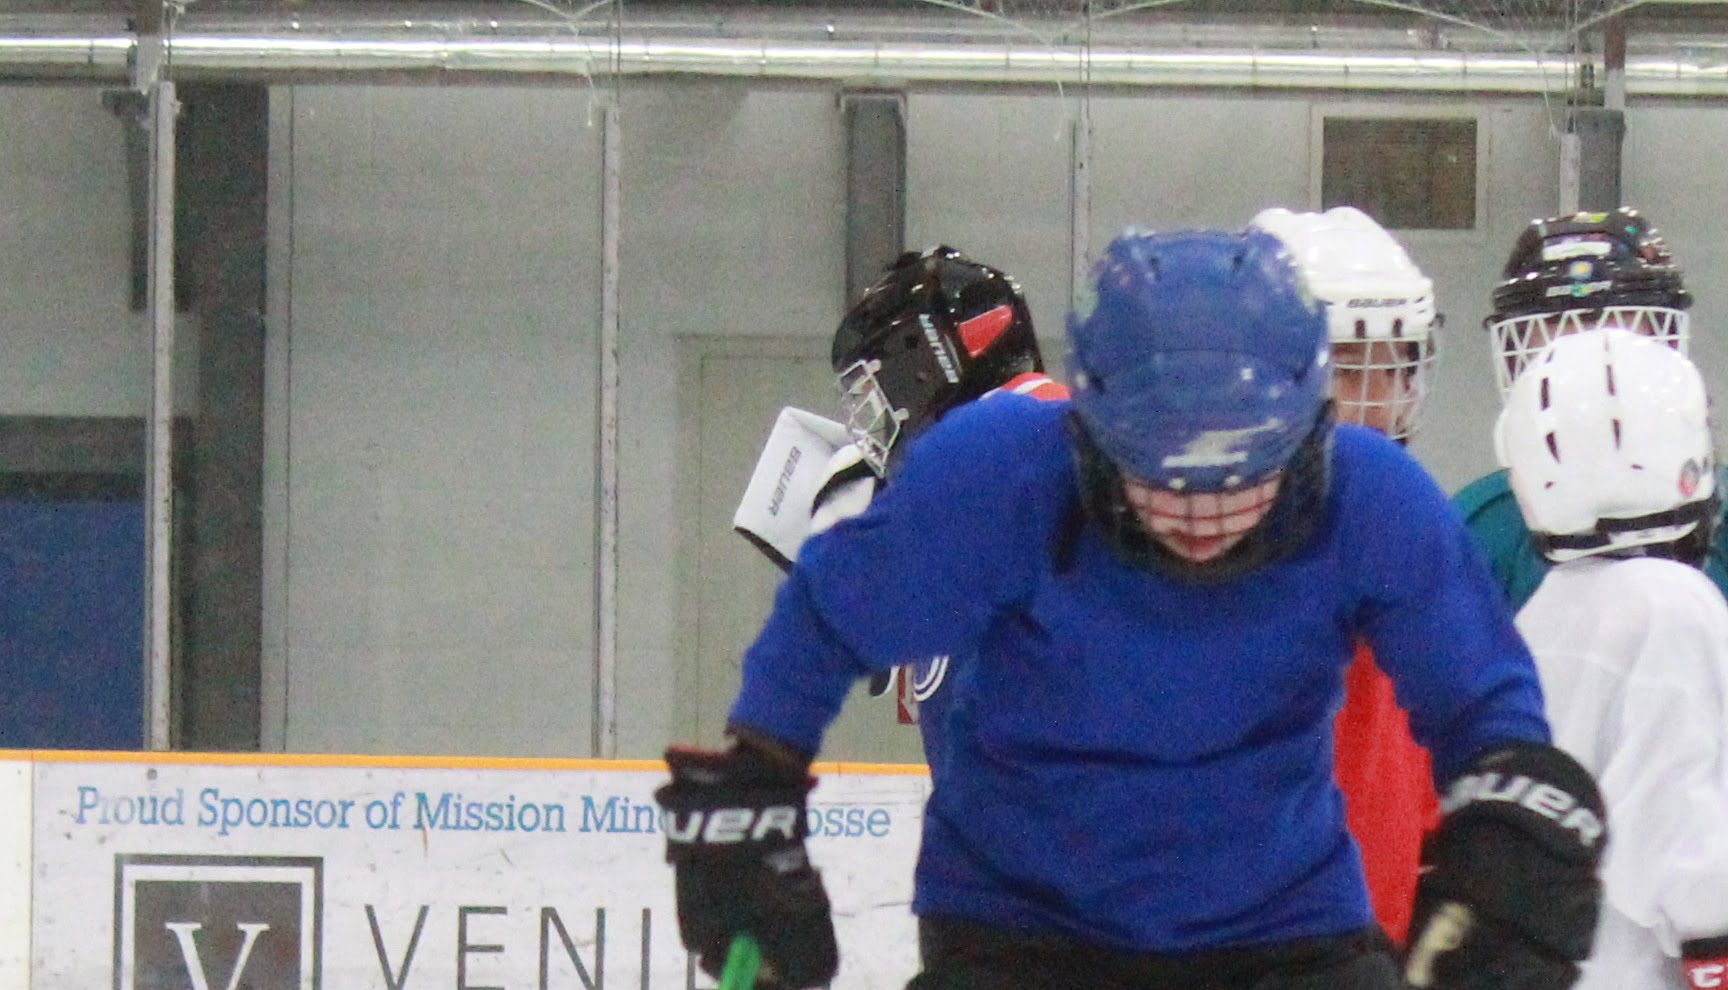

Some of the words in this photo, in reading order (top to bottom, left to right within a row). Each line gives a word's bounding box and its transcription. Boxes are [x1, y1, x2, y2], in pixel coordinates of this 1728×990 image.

[75, 785, 185, 826] Proud
[197, 787, 355, 836] Sponsor
[365, 791, 406, 830] of
[414, 791, 566, 834] Mission
[579, 795, 667, 834] Min
[667, 804, 798, 845] UER
